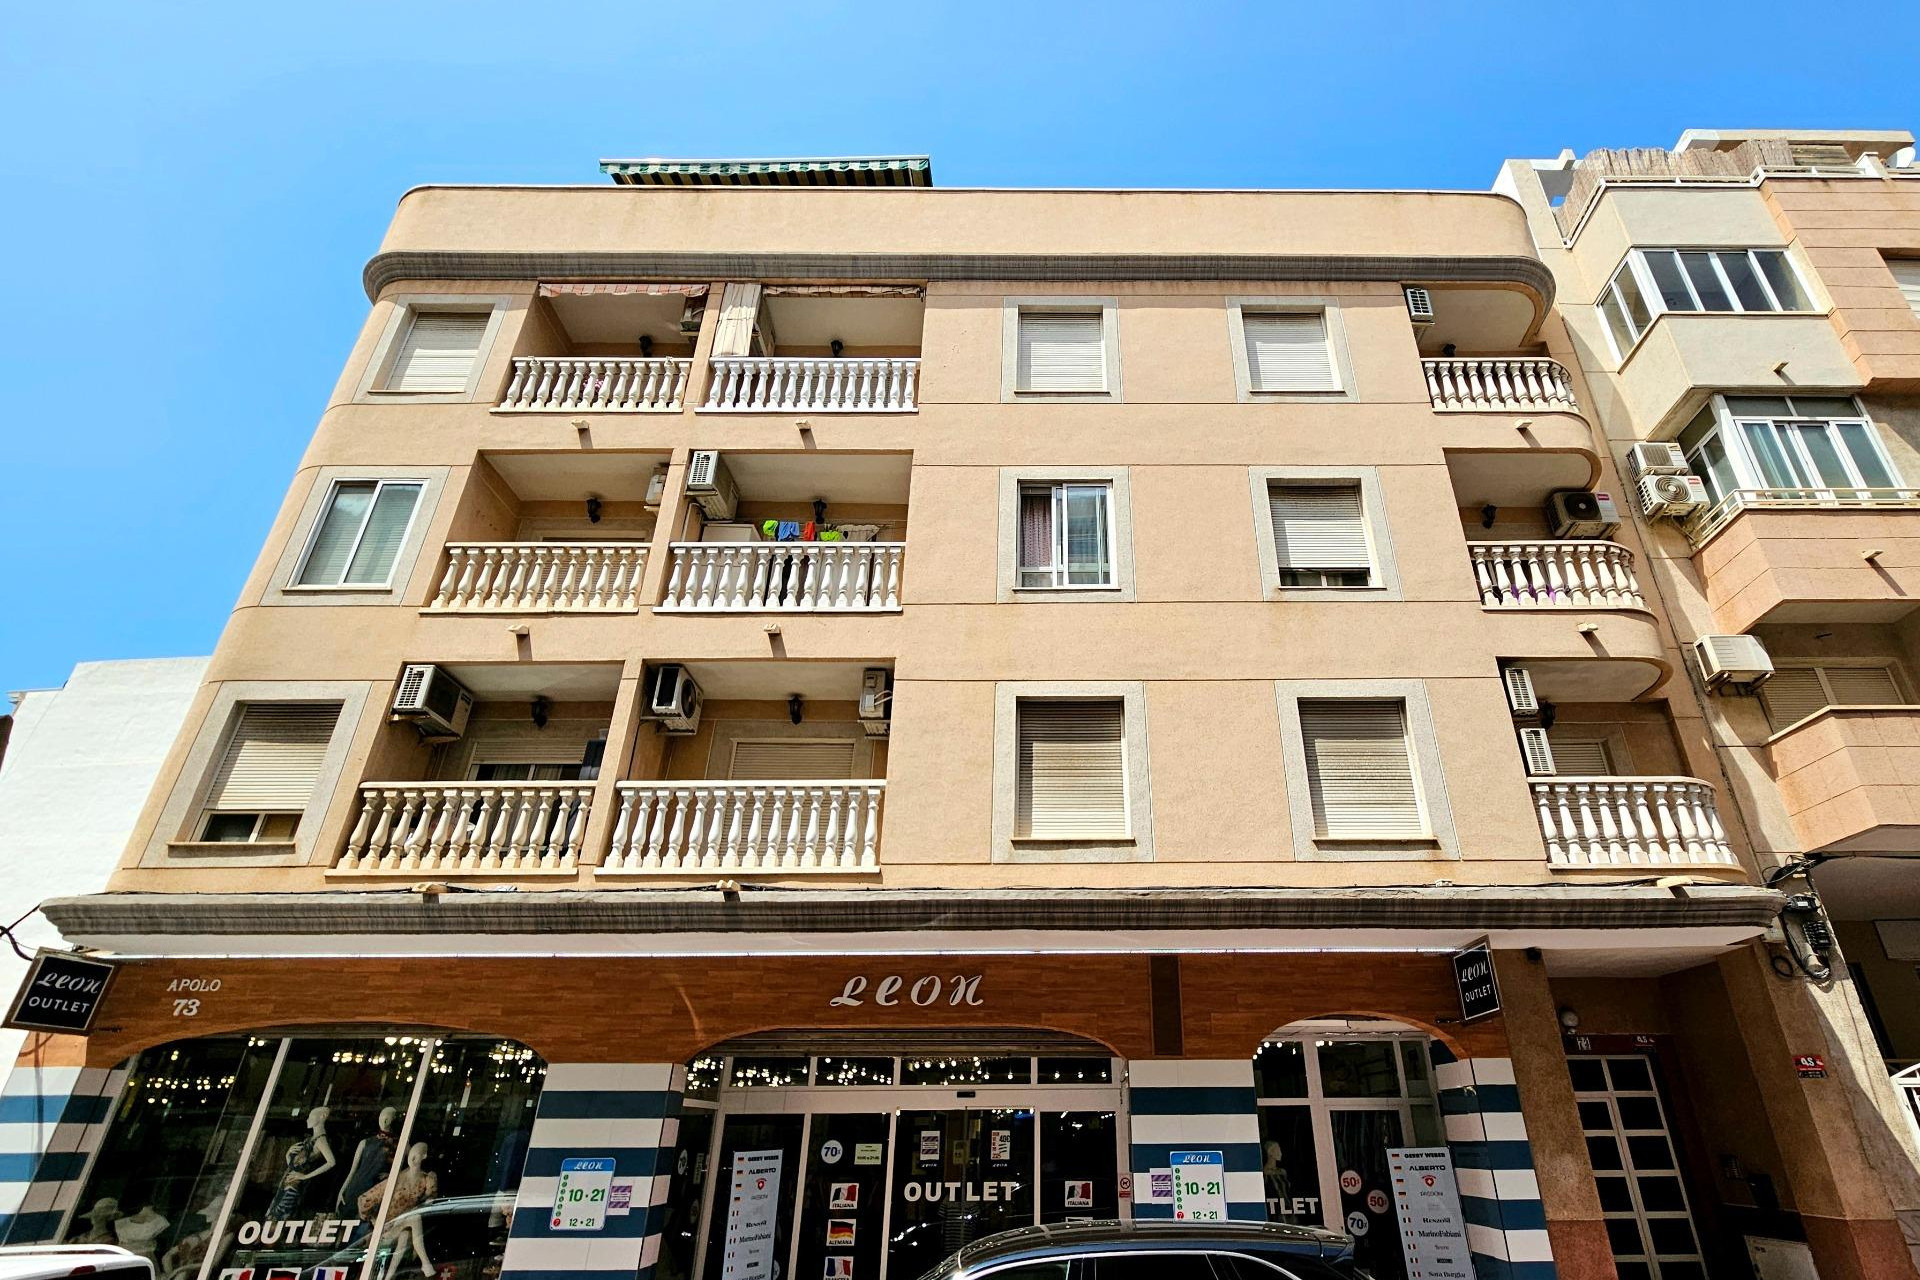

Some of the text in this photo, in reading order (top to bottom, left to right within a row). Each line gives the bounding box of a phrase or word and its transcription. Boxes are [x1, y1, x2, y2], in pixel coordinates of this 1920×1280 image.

[166, 979, 222, 992] APOLO
[1465, 984, 1491, 1002] OUTLET
[28, 996, 90, 1014] OUTLET
[172, 998, 200, 1017] 73
[904, 1181, 1017, 1202] OUTLET
[237, 1219, 361, 1245] OUTLET
